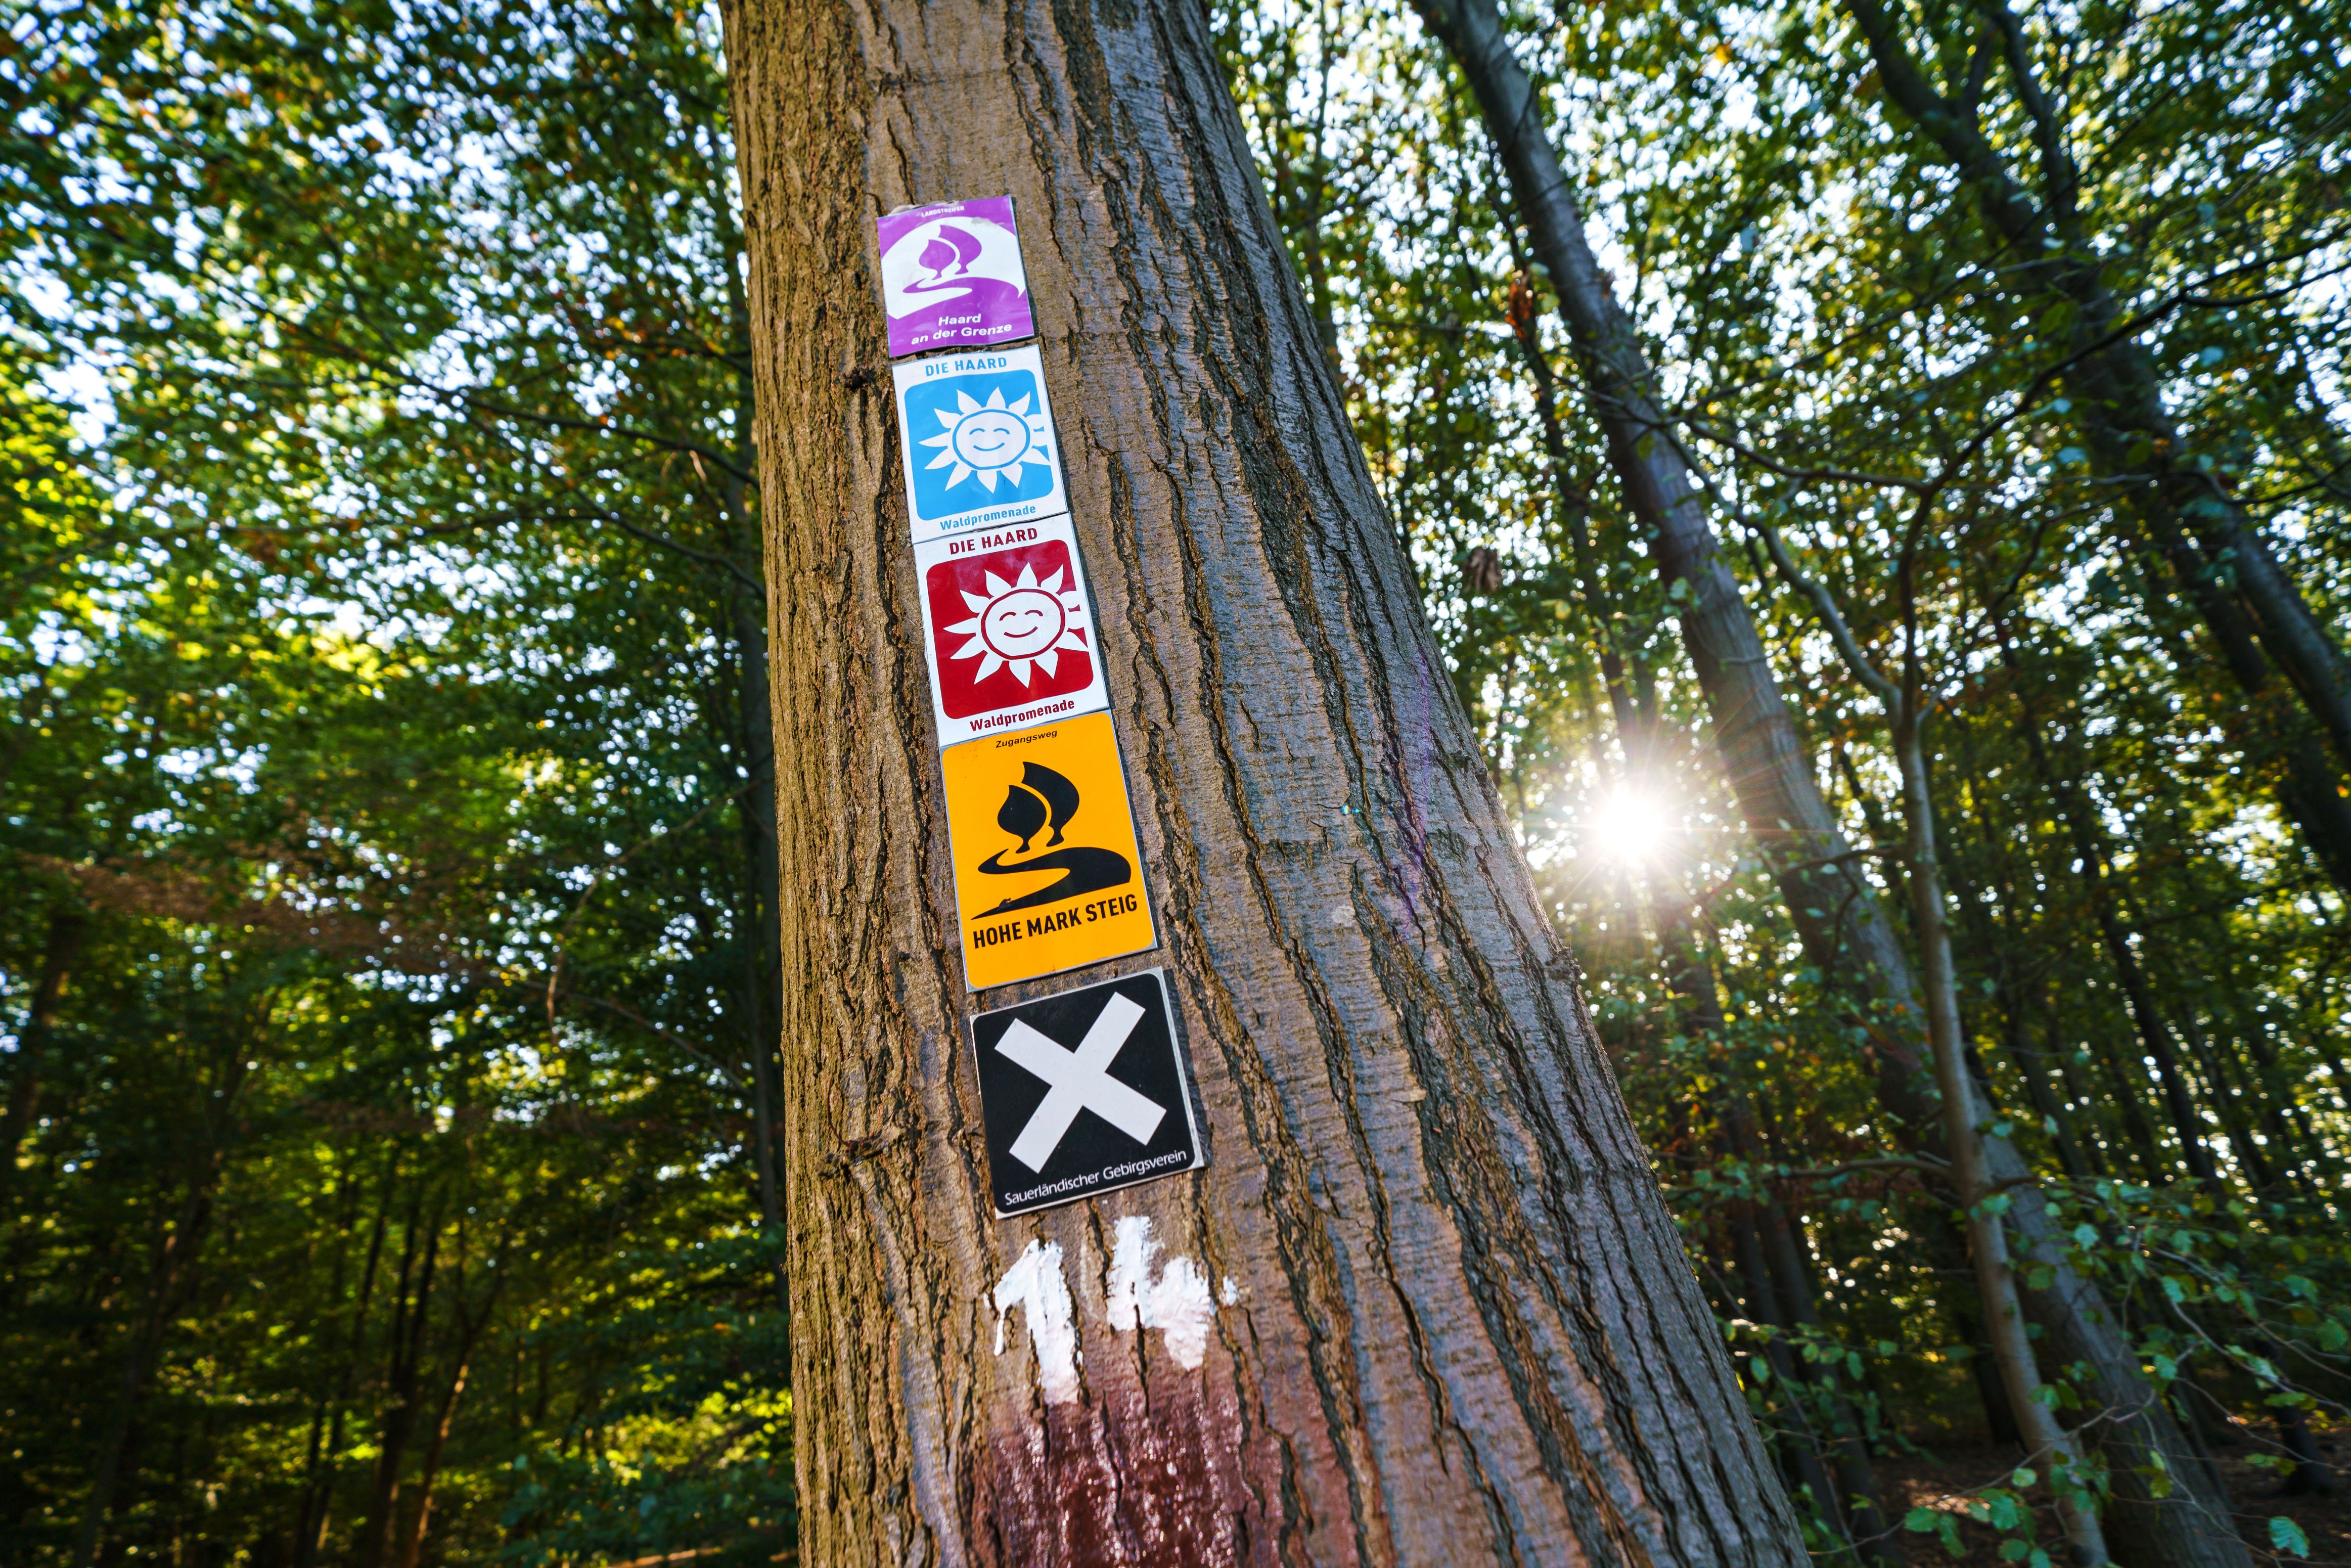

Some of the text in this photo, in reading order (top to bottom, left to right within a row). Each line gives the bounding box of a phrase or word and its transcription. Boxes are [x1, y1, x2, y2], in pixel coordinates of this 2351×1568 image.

[938, 313, 981, 326] Haard
[911, 324, 1012, 345] an der Grenze
[925, 357, 1007, 377] DIE HAARD
[940, 505, 1036, 531] Waldpromenade
[949, 527, 1037, 555] DIE HAARD
[970, 699, 1074, 732] Waldpromenade
[996, 731, 1057, 748] Zugangsweg
[973, 894, 1137, 949] HOHE MARK STEIG
[1005, 1150, 1187, 1206] Sauerländischer Gebirgsverein
